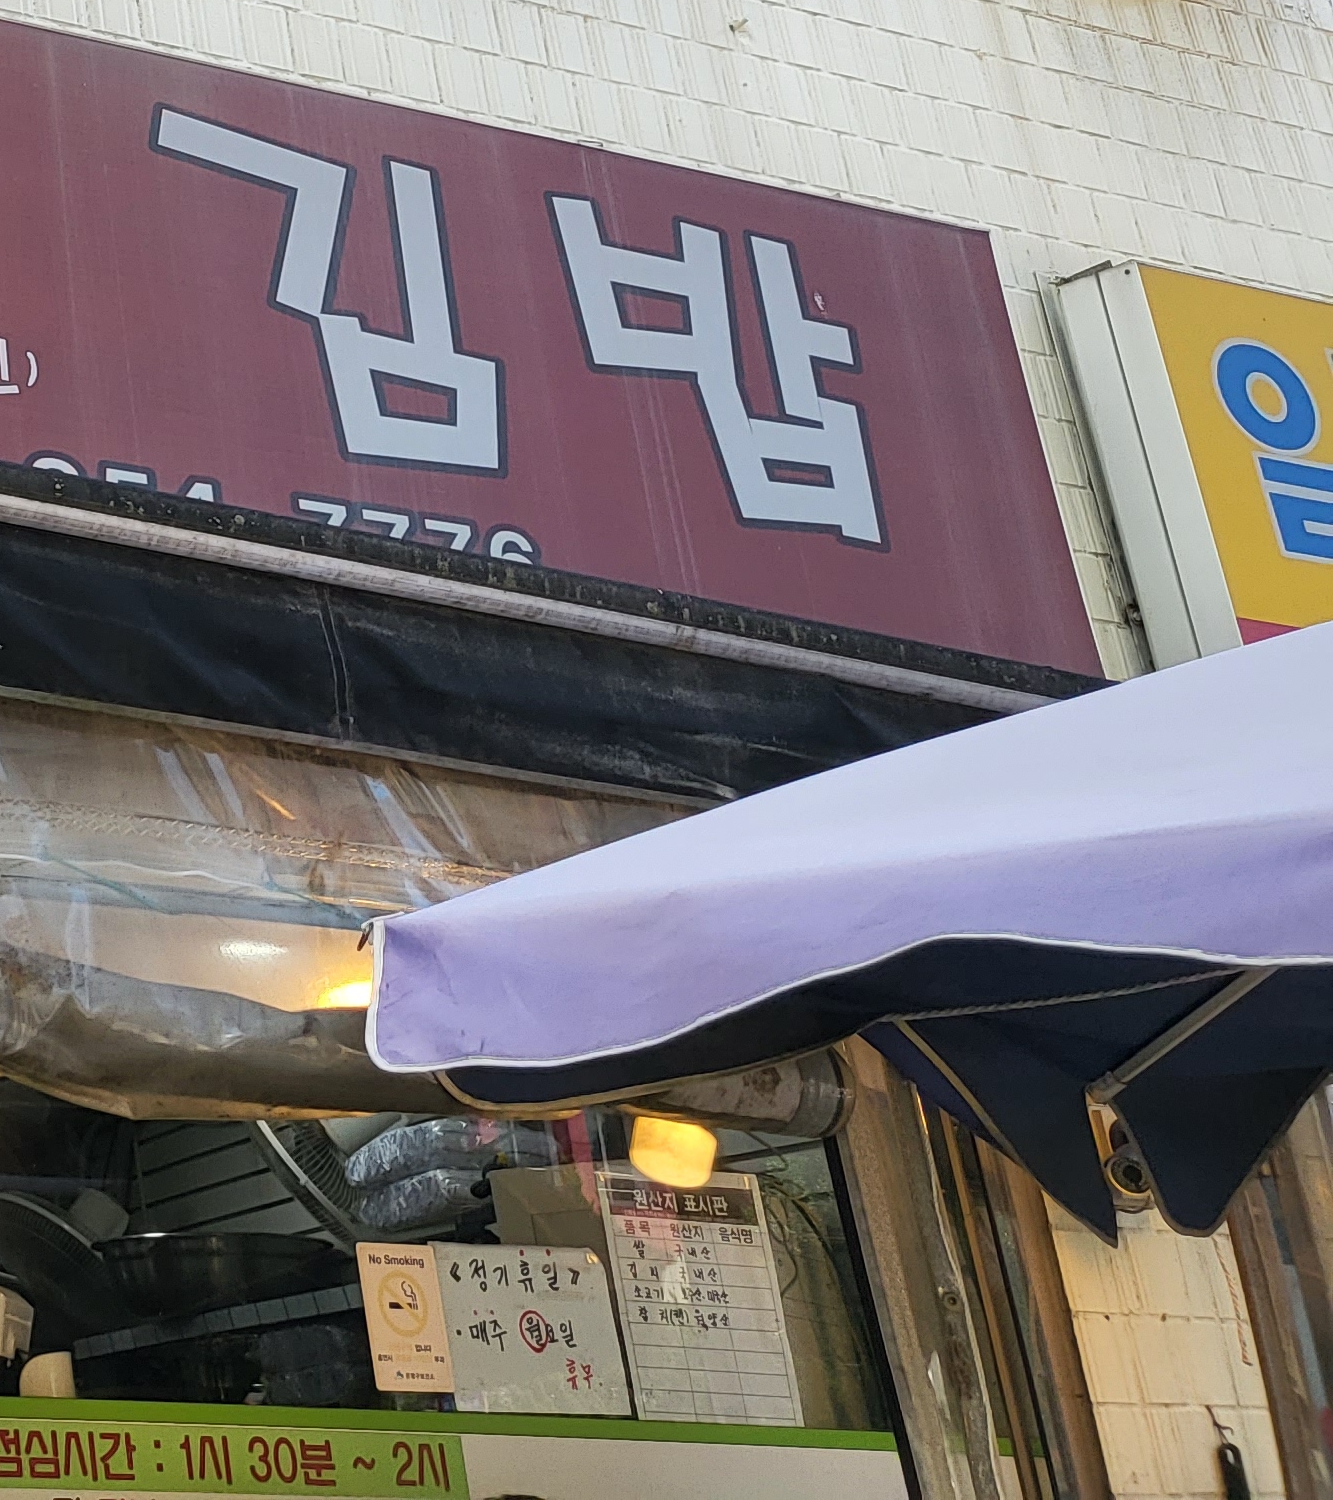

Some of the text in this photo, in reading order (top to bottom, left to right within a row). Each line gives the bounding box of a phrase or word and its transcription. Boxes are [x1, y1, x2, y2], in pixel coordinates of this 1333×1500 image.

[150, 102, 890, 551] 김밥
[633, 1189, 679, 1213] 원산지
[684, 1194, 729, 1216] 표시판
[670, 1223, 705, 1240] 원산지
[718, 1226, 754, 1245] 음식명
[368, 1253, 425, 1269] No Smoking
[525, 1316, 577, 1349] 월요일
[179, 1434, 233, 1486] 1시
[248, 1436, 337, 1488] 30분
[393, 1441, 451, 1492] 2시
